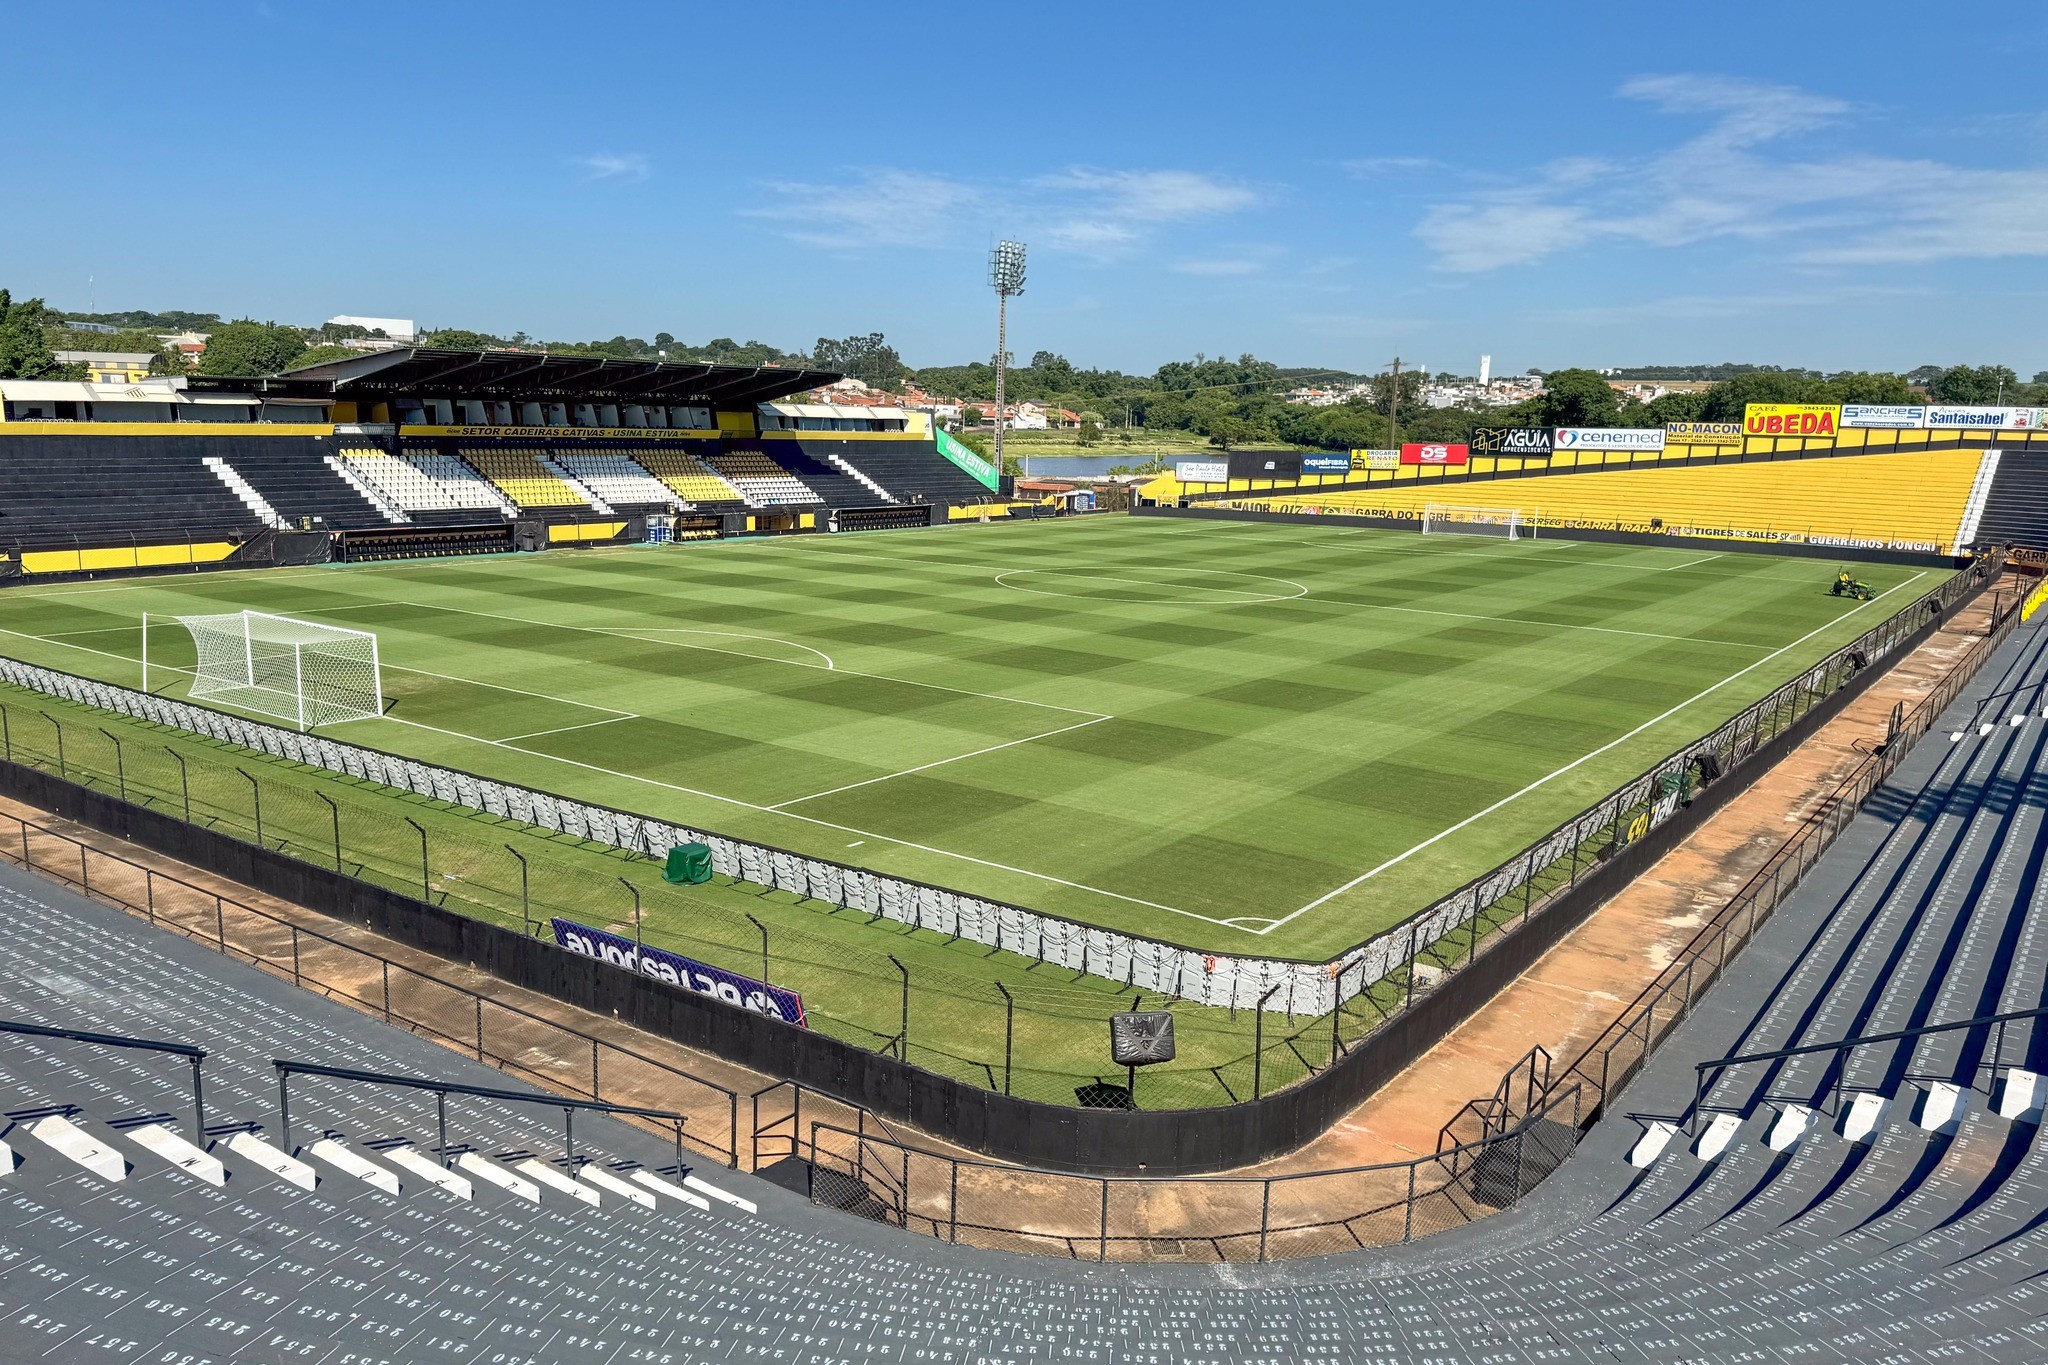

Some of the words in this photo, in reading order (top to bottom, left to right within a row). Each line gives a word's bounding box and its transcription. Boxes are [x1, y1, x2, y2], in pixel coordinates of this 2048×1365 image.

[1747, 412, 1834, 434] ÚBEDA
[1929, 412, 2005, 425] Santaisabel
[462, 427, 500, 437] SETOR
[504, 428, 559, 438] CADEIRAS
[562, 428, 605, 438] CATIVAS
[613, 429, 642, 438] USINA
[645, 429, 679, 438] ESTIVA
[1668, 423, 1741, 434] NO-MACON
[1581, 431, 1662, 443] cenemed
[946, 439, 966, 461] USINA
[966, 455, 990, 478] ESTIVA
[1420, 446, 1448, 458] DS
[1232, 502, 1271, 513] MAIOR
[1356, 508, 1393, 520] GARRA
[1397, 510, 1414, 520] DO
[1417, 511, 1451, 522] TGRE
[1525, 517, 1562, 526] SERSEG
[1575, 520, 1617, 531] GARRA
[1694, 527, 1733, 537] TIGRES
[1746, 531, 1778, 540] SALES
[1809, 534, 1884, 549] GUERREIROS
[2013, 549, 2048, 563] GARR
[92, 1234, 131, 1250] 257
[28, 1263, 70, 1282] 258
[189, 1268, 229, 1286] 255
[81, 1282, 128, 1300] 257
[329, 1275, 368, 1292] 252
[240, 1286, 281, 1305] 254
[383, 1292, 422, 1309] 251
[506, 1296, 544, 1311] 248
[618, 1301, 655, 1315] 245
[18, 1313, 68, 1335] 258
[438, 1309, 477, 1325] 250
[560, 1309, 600, 1324] 247
[675, 1311, 712, 1325] 244
[204, 1316, 251, 1336] 255
[361, 1320, 405, 1338] 252
[732, 1322, 769, 1336] 243
[84, 1333, 139, 1353] 257
[426, 1336, 469, 1354] 251
[680, 1335, 721, 1349] 245
[790, 1332, 829, 1347] 242
[744, 1344, 785, 1359] 244
[854, 1342, 891, 1354] 241
[915, 1349, 953, 1362] 240
[1001, 1344, 1038, 1354] 237
[628, 1348, 673, 1364] 247
